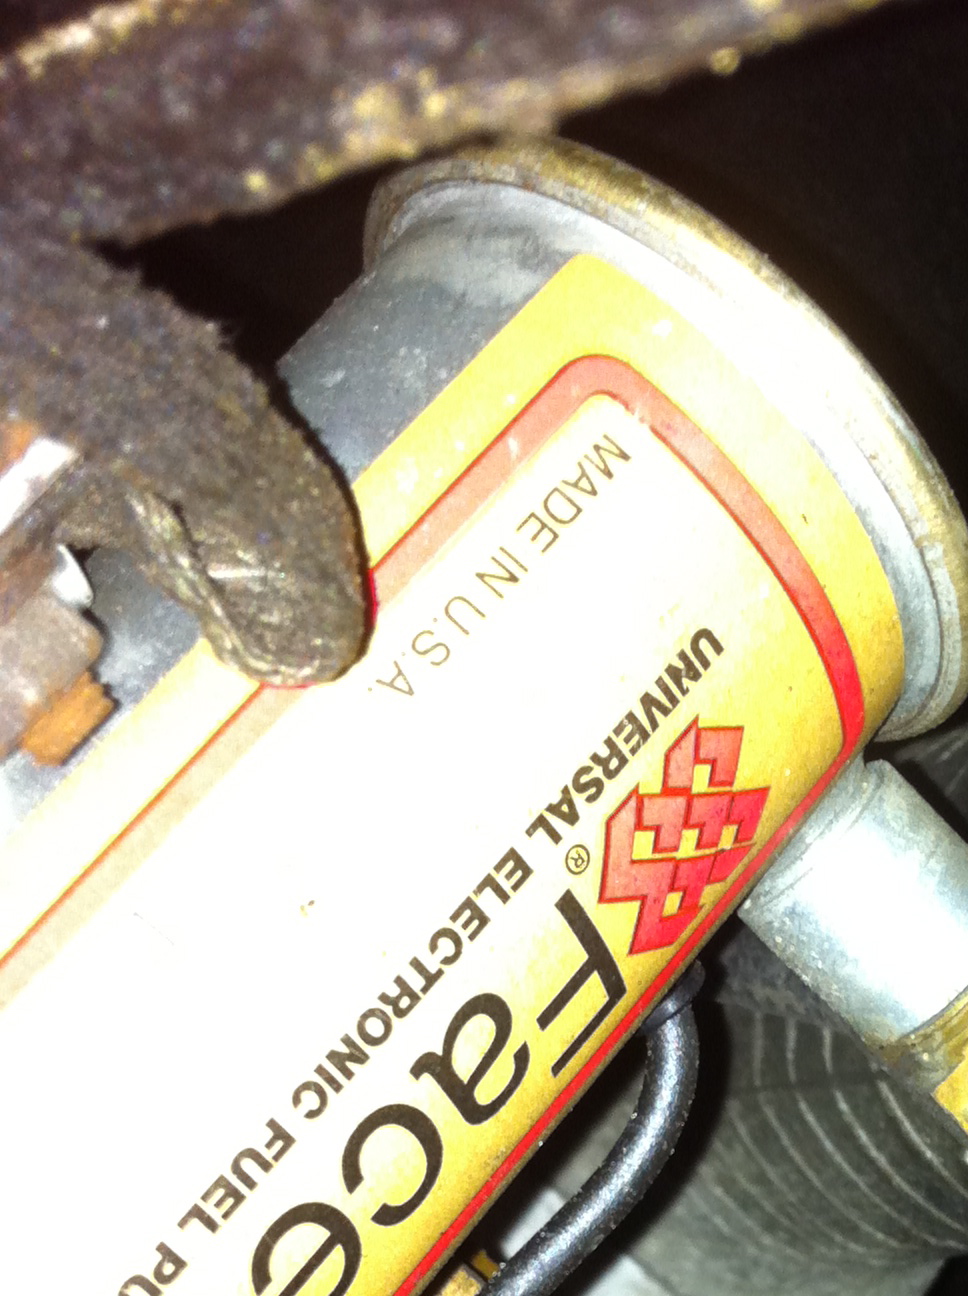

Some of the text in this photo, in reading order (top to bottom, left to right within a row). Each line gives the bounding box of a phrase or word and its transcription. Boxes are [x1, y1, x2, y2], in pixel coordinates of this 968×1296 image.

[367, 433, 631, 697] MADE IN U.S.A.
[525, 628, 725, 846] UNIVERSAL
[292, 847, 534, 1120] ELECTRONIC
[177, 1117, 296, 1234] FUEL
